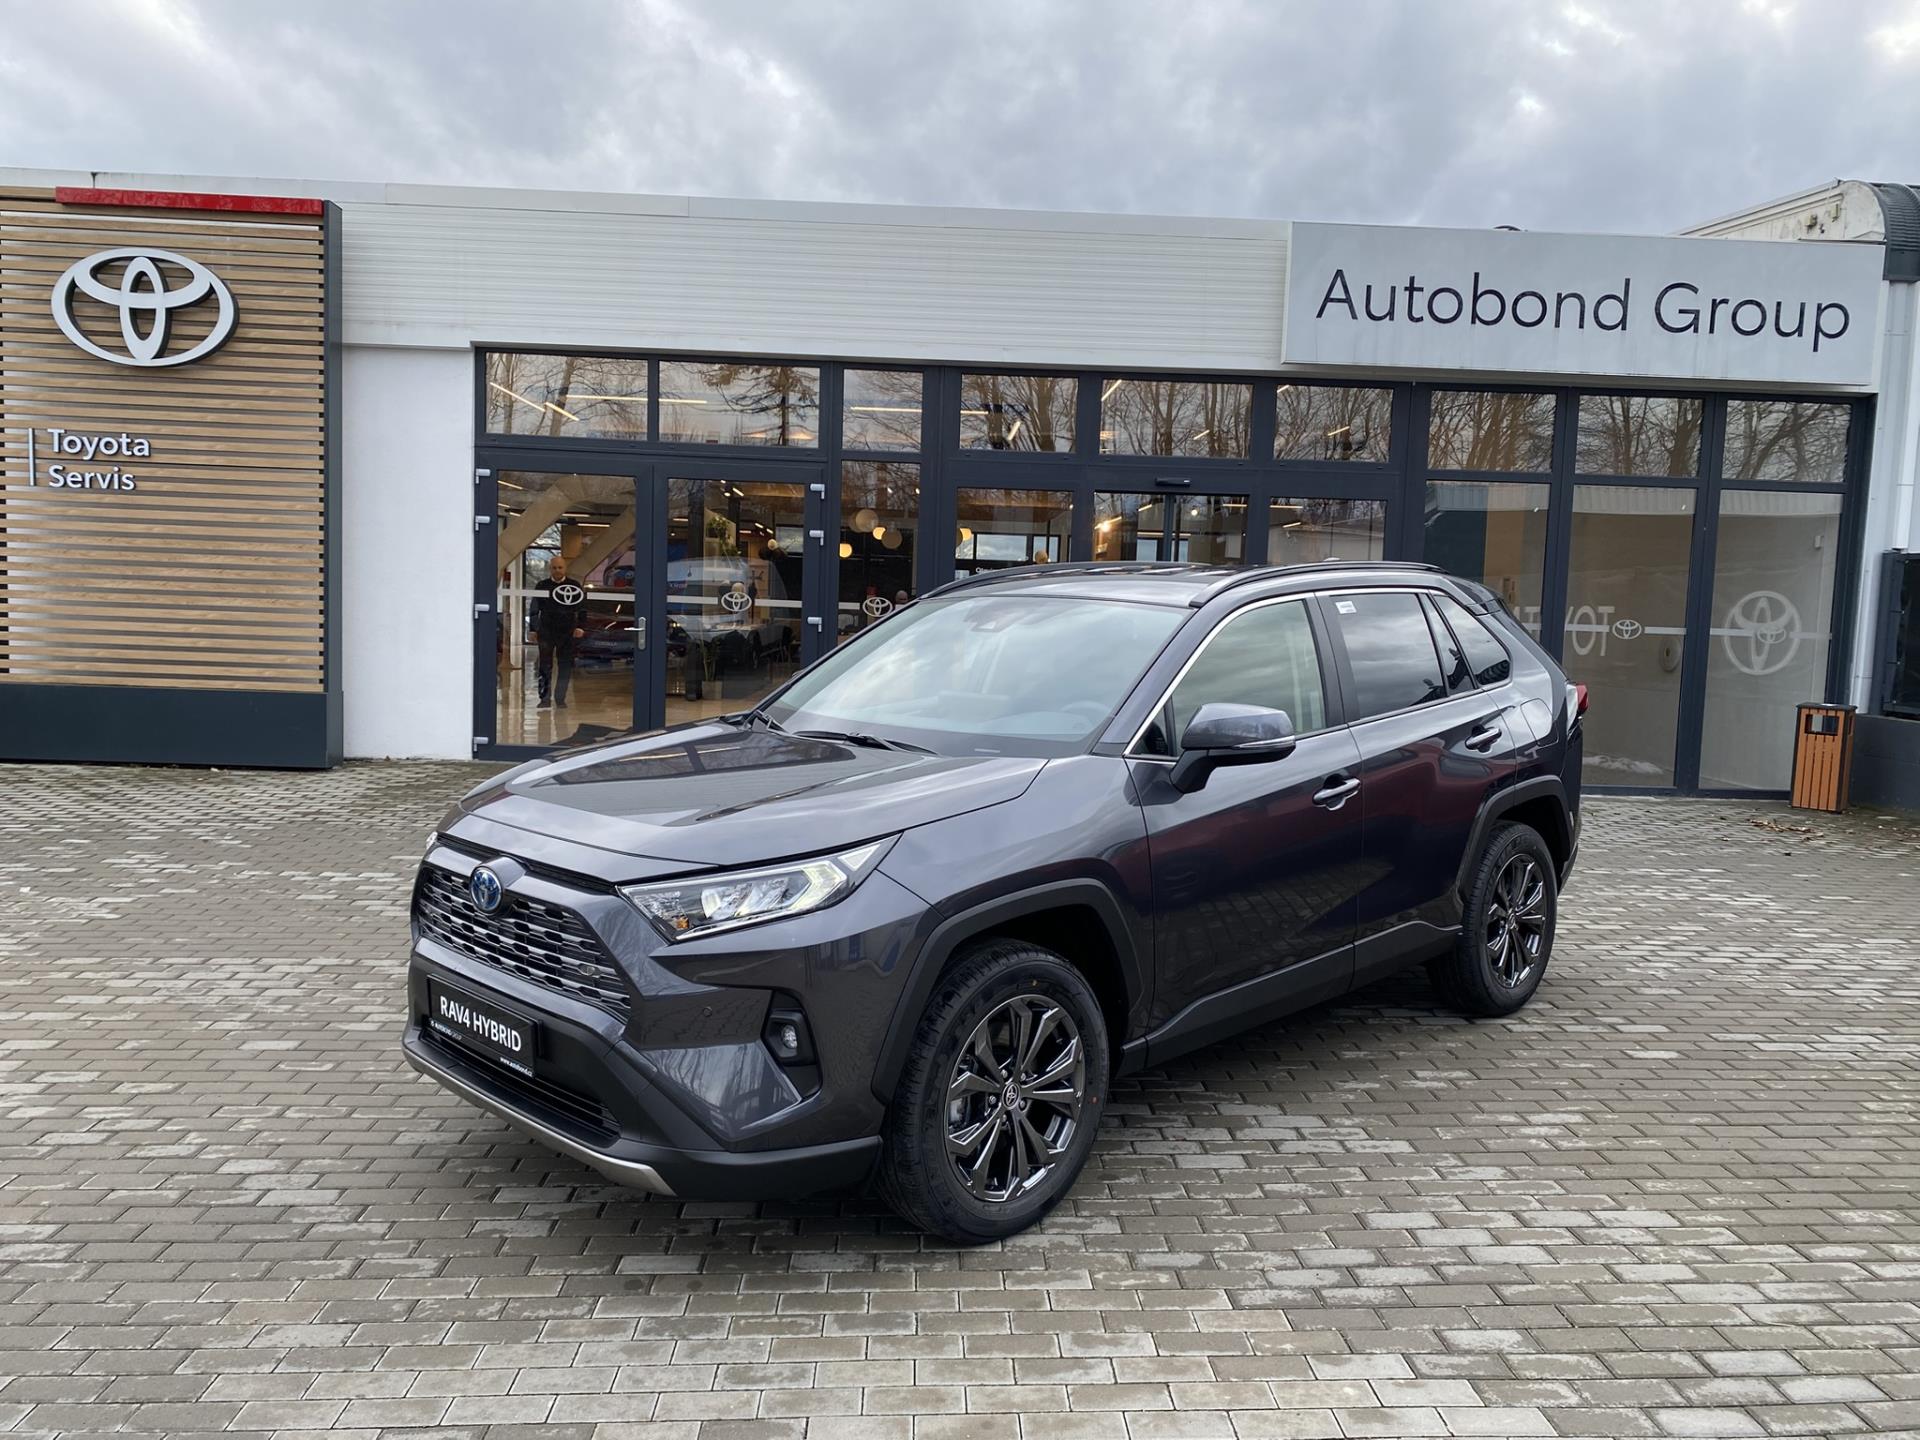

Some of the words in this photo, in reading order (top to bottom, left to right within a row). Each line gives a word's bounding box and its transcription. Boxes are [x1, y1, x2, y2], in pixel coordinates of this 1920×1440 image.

[1315, 268, 1631, 332] Autobond
[1654, 281, 1850, 353] Group
[47, 428, 151, 460] Toyota
[48, 464, 136, 491] Servis
[440, 995, 471, 1028] RAV4
[473, 1011, 522, 1052] HYBRID
